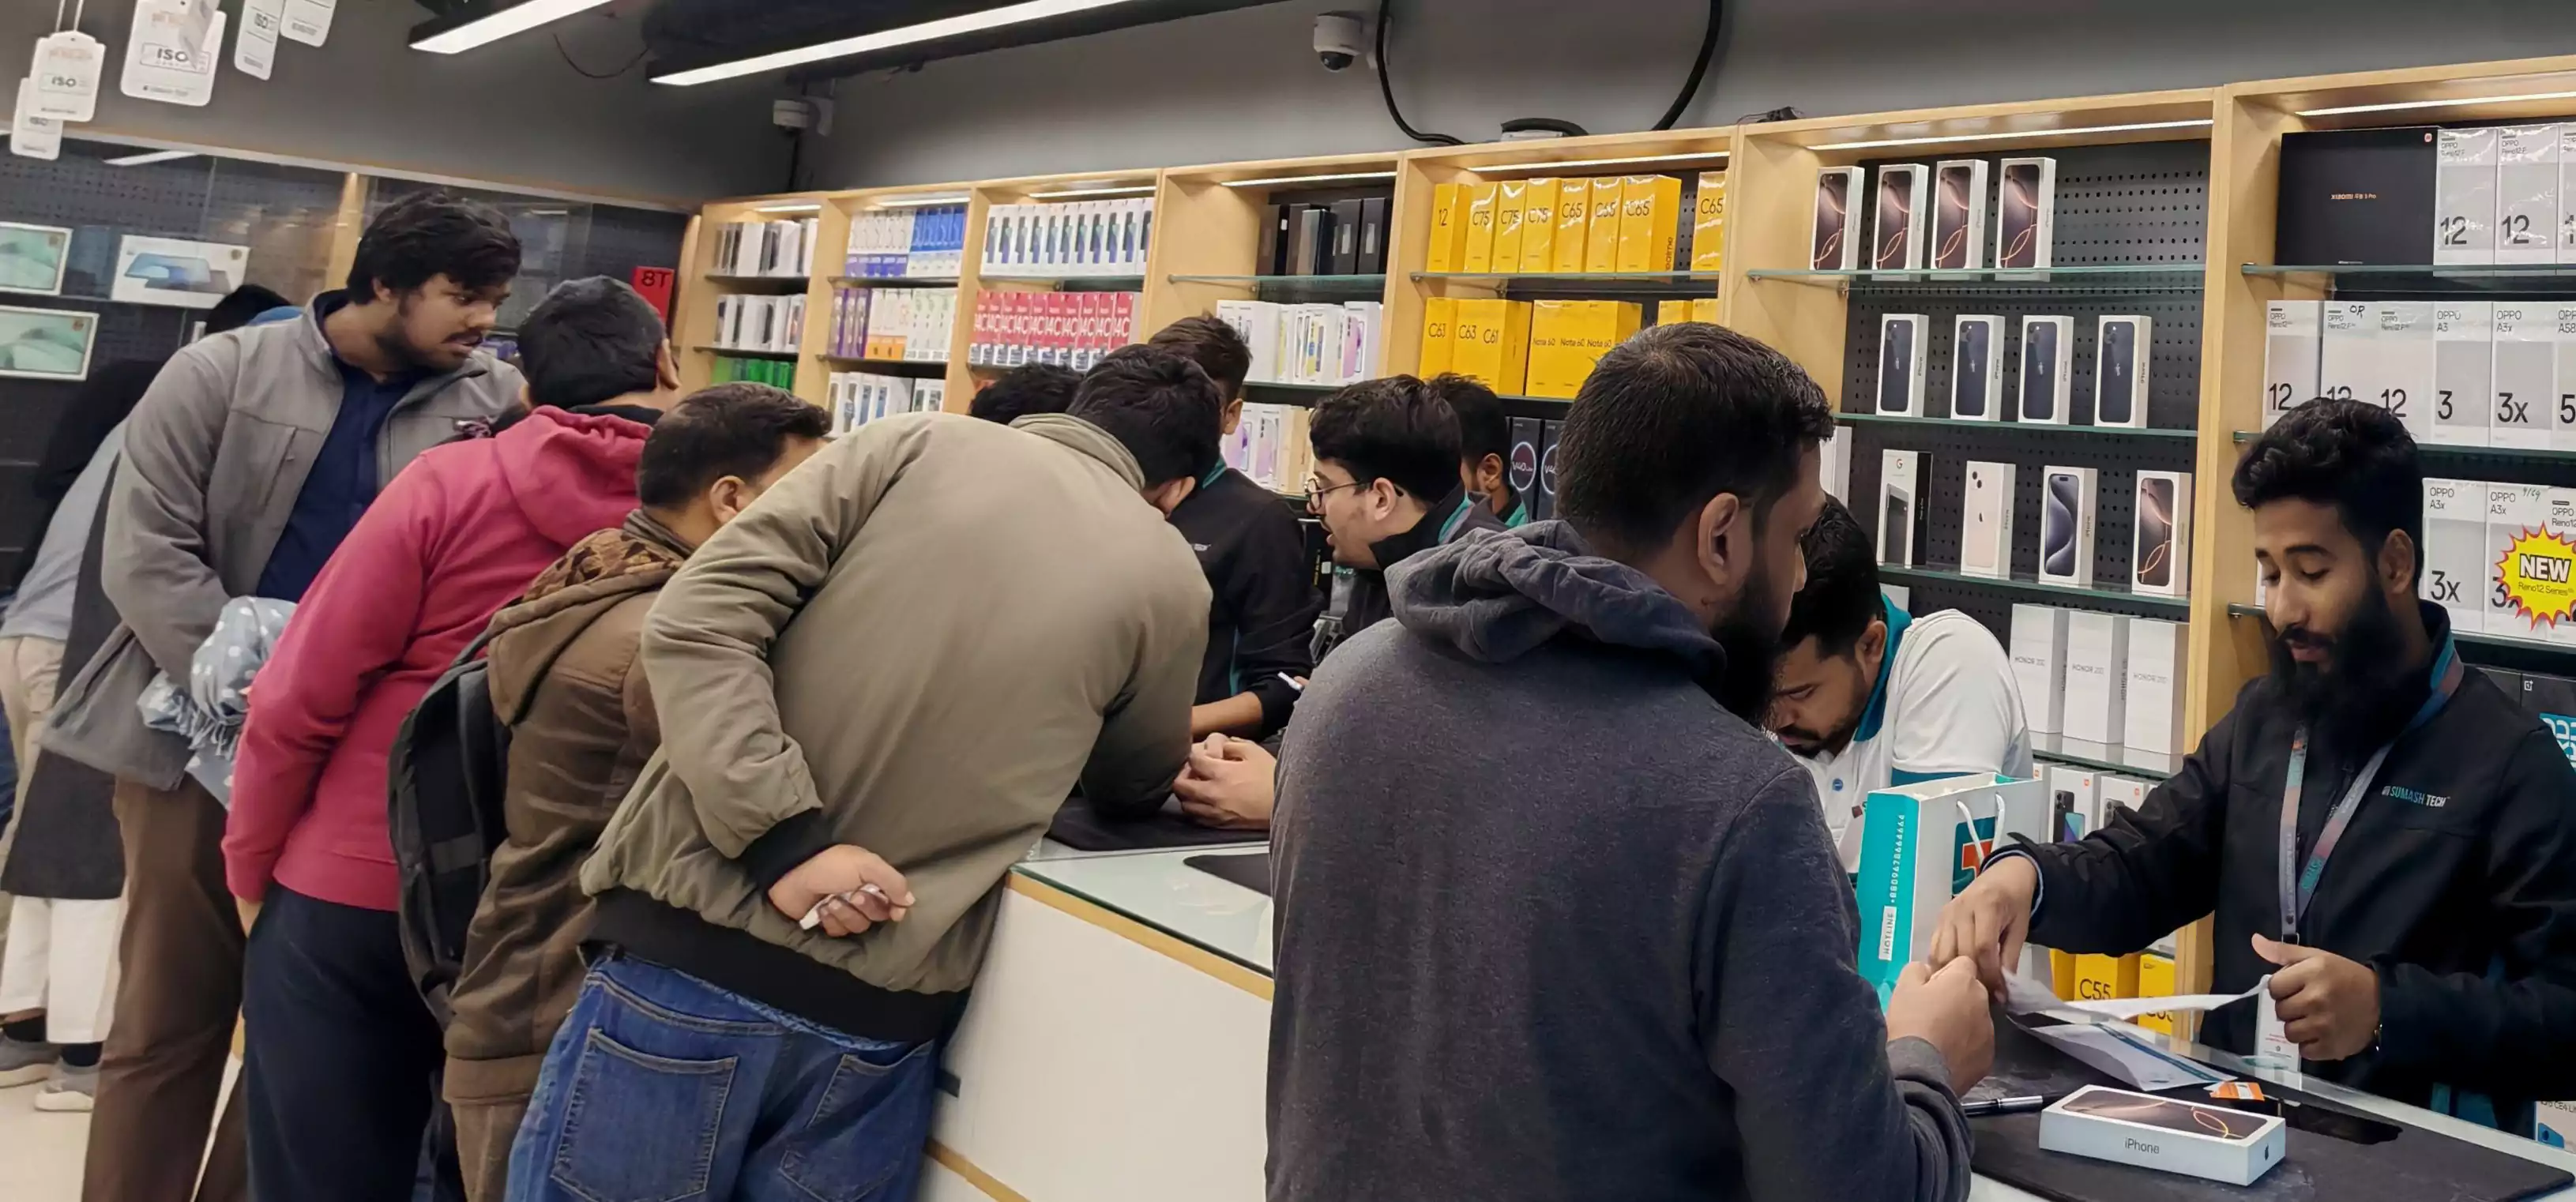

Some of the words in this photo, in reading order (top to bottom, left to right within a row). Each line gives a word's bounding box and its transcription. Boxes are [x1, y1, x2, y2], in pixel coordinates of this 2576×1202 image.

[156, 47, 190, 62] ISO
[51, 76, 77, 88] ISO
[1562, 202, 1583, 218] C65
[1626, 200, 1650, 216] C65
[1700, 197, 1723, 215] C65
[1438, 208, 1449, 227] 12
[1472, 211, 1491, 226] C75
[1501, 209, 1521, 225] C75
[2440, 216, 2467, 245] 12
[2501, 215, 2529, 244] 12
[1665, 236, 1674, 270] ealme
[2349, 305, 2365, 319] OR
[2437, 310, 2461, 320] OPPO
[2496, 310, 2522, 320] OPPO
[2558, 310, 2576, 321] OPP
[1428, 322, 1446, 338] C63
[1458, 325, 1477, 339] C63
[2436, 322, 2448, 332] A3
[2496, 323, 2513, 332] A3x
[1484, 329, 1499, 344] C61
[2269, 382, 2292, 411] 12
[2381, 388, 2407, 417] 12
[2438, 389, 2453, 420] 3
[2497, 392, 2529, 423] 3x
[2559, 393, 2576, 424] 5
[2430, 486, 2454, 498] OPPO
[2490, 491, 2516, 503] OPPO
[2429, 499, 2445, 509] A3x
[2490, 505, 2506, 515] A3x
[2552, 507, 2574, 516] OPPO
[2519, 553, 2572, 584] NEW
[2430, 569, 2461, 603] 3x
[2518, 581, 2544, 593] Reno12
[2072, 663, 2093, 673] HONOR
[2390, 786, 2425, 805] SUMASH
[2426, 794, 2446, 807] TECH
[1882, 913, 1893, 955] HOTLINE
[2079, 978, 2112, 1001] C55
[2124, 1137, 2160, 1155] iPhone
